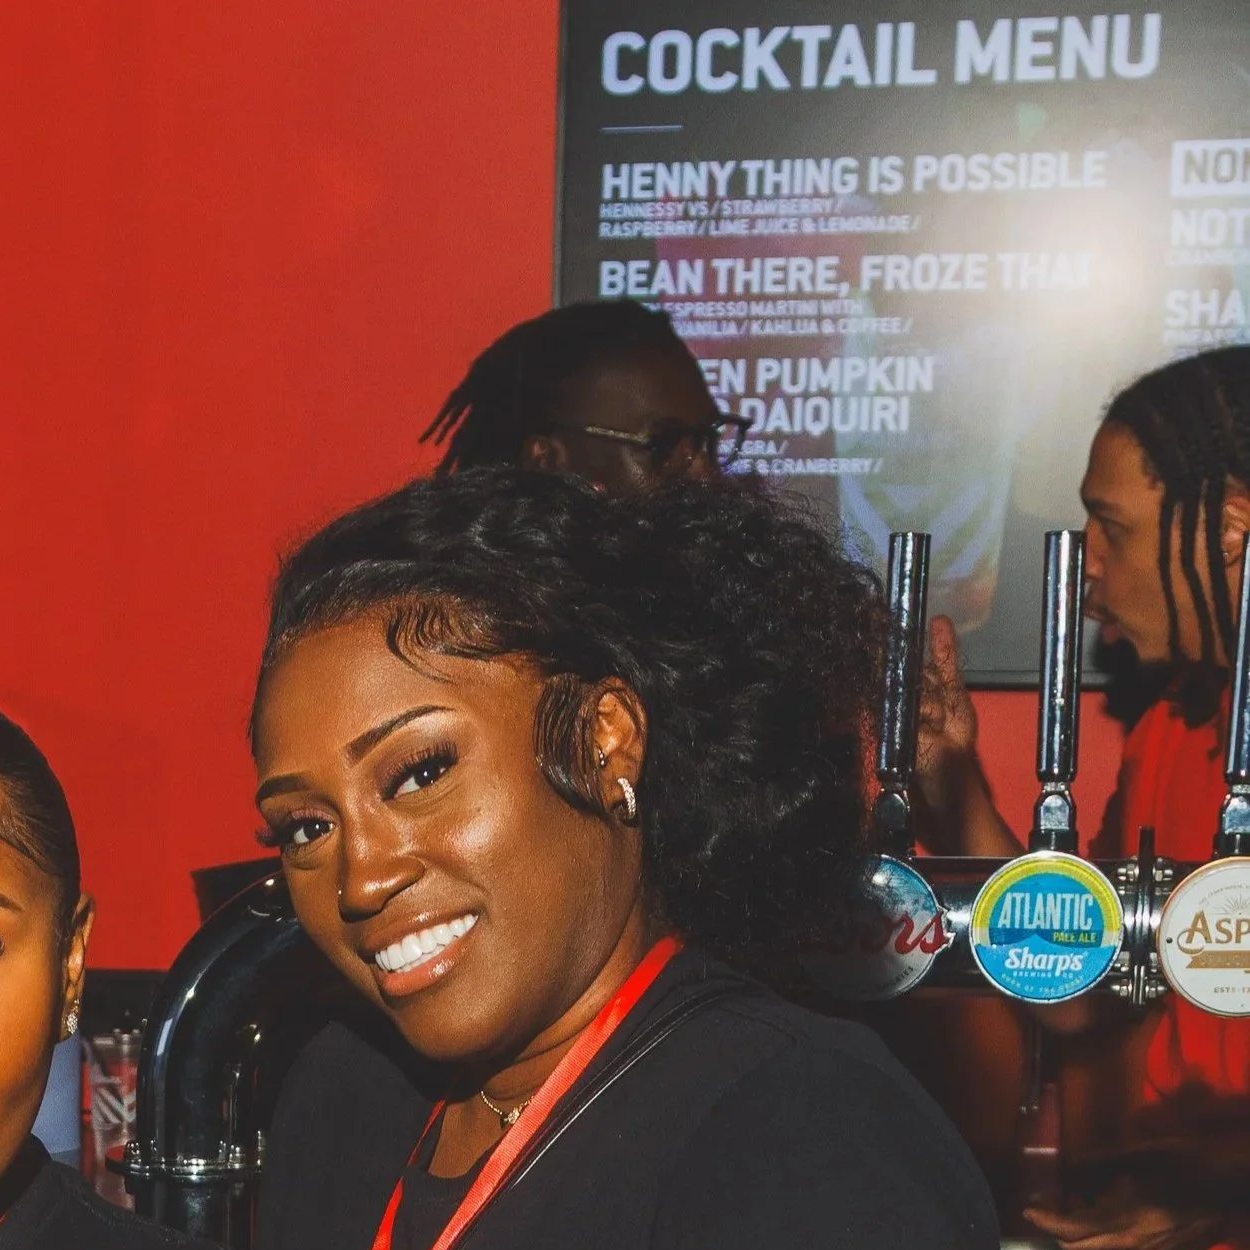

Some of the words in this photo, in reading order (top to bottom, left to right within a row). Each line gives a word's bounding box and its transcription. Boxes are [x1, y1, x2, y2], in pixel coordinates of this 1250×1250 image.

[602, 22, 937, 94] COCKTAIL
[954, 13, 1161, 83] MENU
[602, 160, 736, 199] HENNY
[740, 157, 859, 196] THING
[868, 155, 904, 193] IS
[912, 150, 1107, 194] POSSIBLE
[598, 219, 697, 237] RASPBERRY
[709, 217, 750, 236] LIME
[753, 216, 799, 235] JUICE
[818, 214, 911, 233] LEMONADE
[599, 201, 684, 219] HENNESSY
[720, 197, 834, 217] STRAWBERRY
[600, 258, 704, 296] BEAN
[710, 255, 850, 298] THERE,
[860, 253, 988, 292] FROZE
[997, 251, 1093, 291] THAT
[750, 301, 818, 316] MARTINI
[821, 299, 863, 315] WITH
[751, 318, 820, 336] KAHLUA
[838, 316, 901, 334] COFFEE
[1164, 289, 1246, 327] SHA
[698, 358, 747, 393] EN
[755, 356, 934, 393] PUMPKIN
[739, 396, 910, 437] DAIQUIRI
[771, 457, 874, 474] CRANBERRY
[997, 892, 1094, 930] ATLANTIC
[1053, 932, 1077, 943] PALE
[1078, 932, 1096, 943] ALE
[1177, 908, 1250, 955] ASP
[1004, 946, 1084, 977] Sharp's
